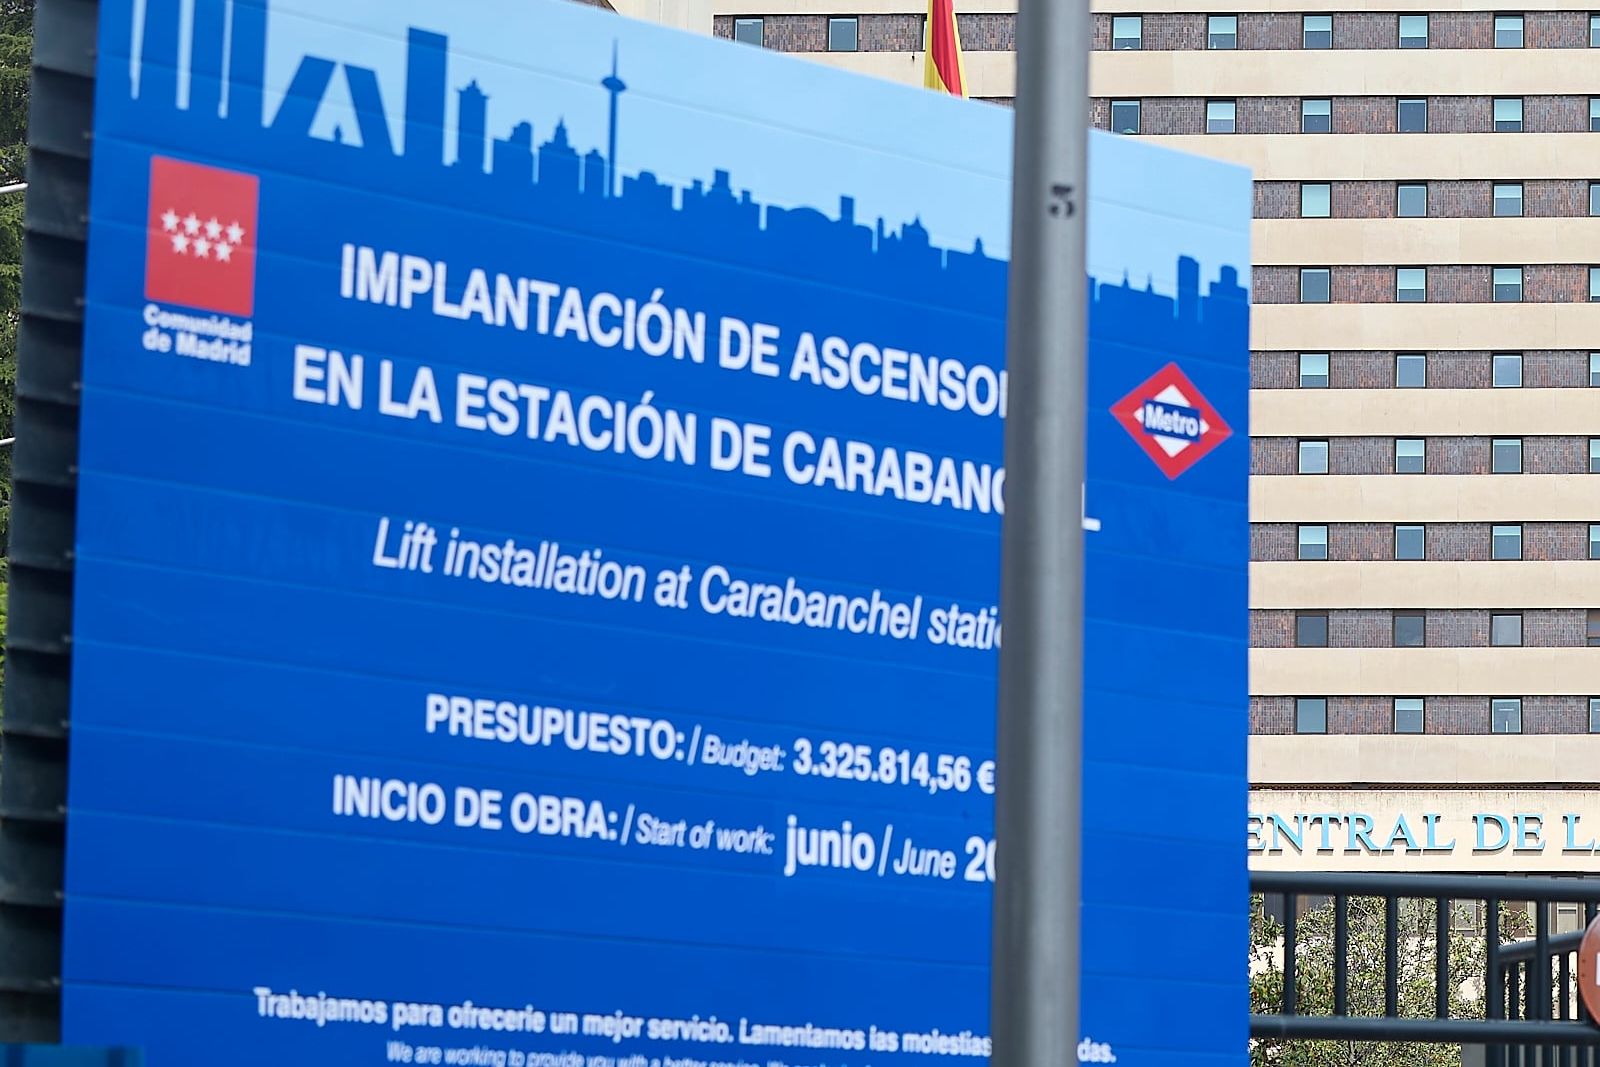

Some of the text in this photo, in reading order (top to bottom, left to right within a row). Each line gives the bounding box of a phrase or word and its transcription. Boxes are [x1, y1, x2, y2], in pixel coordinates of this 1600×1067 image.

[142, 327, 252, 367] de Madrid
[143, 303, 253, 343] Comunidad
[341, 243, 1008, 418] IMPLANTACIÓN DE ASCENSO
[293, 345, 363, 409] EN
[379, 360, 442, 423] LA
[456, 373, 697, 465] ESTACIÓN
[710, 418, 771, 478] DE
[1145, 403, 1199, 437] Metro
[373, 517, 1002, 650] Lift installation at Carabanchel stati
[793, 738, 971, 794] 3.325.814,56
[976, 759, 996, 794] €
[333, 775, 446, 824] INICIO
[455, 787, 503, 830] DE
[636, 810, 686, 849] Start
[689, 816, 716, 850] of
[717, 826, 774, 856] work:
[784, 815, 875, 877] junio
[893, 838, 956, 880] June
[1248, 813, 1455, 852] ENTRAL
[1472, 813, 1546, 851] DE
[253, 986, 388, 1027] Trabajamos
[390, 996, 443, 1032] para
[447, 1001, 546, 1033] ofrecerle
[549, 1010, 579, 1035] un
[581, 1009, 645, 1044] mejor
[646, 1014, 735, 1044] servicio.
[738, 1018, 866, 1050] Lamentamos
[868, 1024, 899, 1052] las
[901, 1028, 993, 1057] molestias
